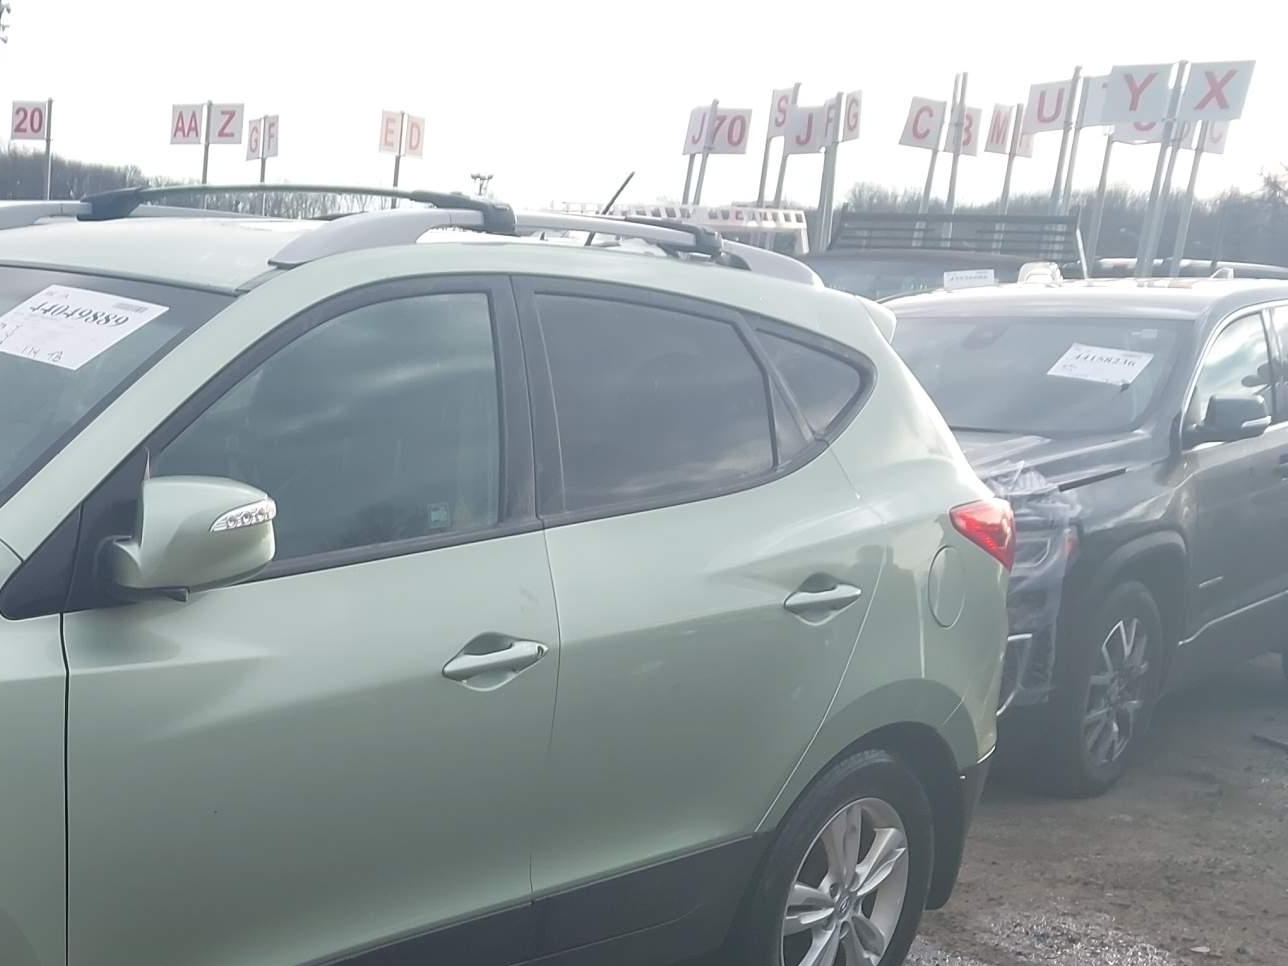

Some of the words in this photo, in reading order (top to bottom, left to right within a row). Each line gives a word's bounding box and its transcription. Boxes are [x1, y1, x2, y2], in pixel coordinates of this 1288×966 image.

[1037, 87, 1065, 123] U
[1123, 72, 1159, 112] Y
[1194, 69, 1239, 111] X
[14, 107, 43, 133] 20
[173, 110, 199, 137] AA
[217, 110, 236, 137] Z
[775, 95, 789, 127] S
[846, 98, 859, 131] G
[912, 105, 934, 140] C
[249, 126, 258, 153] G
[268, 122, 275, 151] F
[384, 117, 396, 147] E
[409, 121, 421, 151] D
[691, 112, 706, 145] J
[712, 115, 746, 146] 70
[795, 112, 813, 145] J
[29, 301, 129, 327] 44049889
